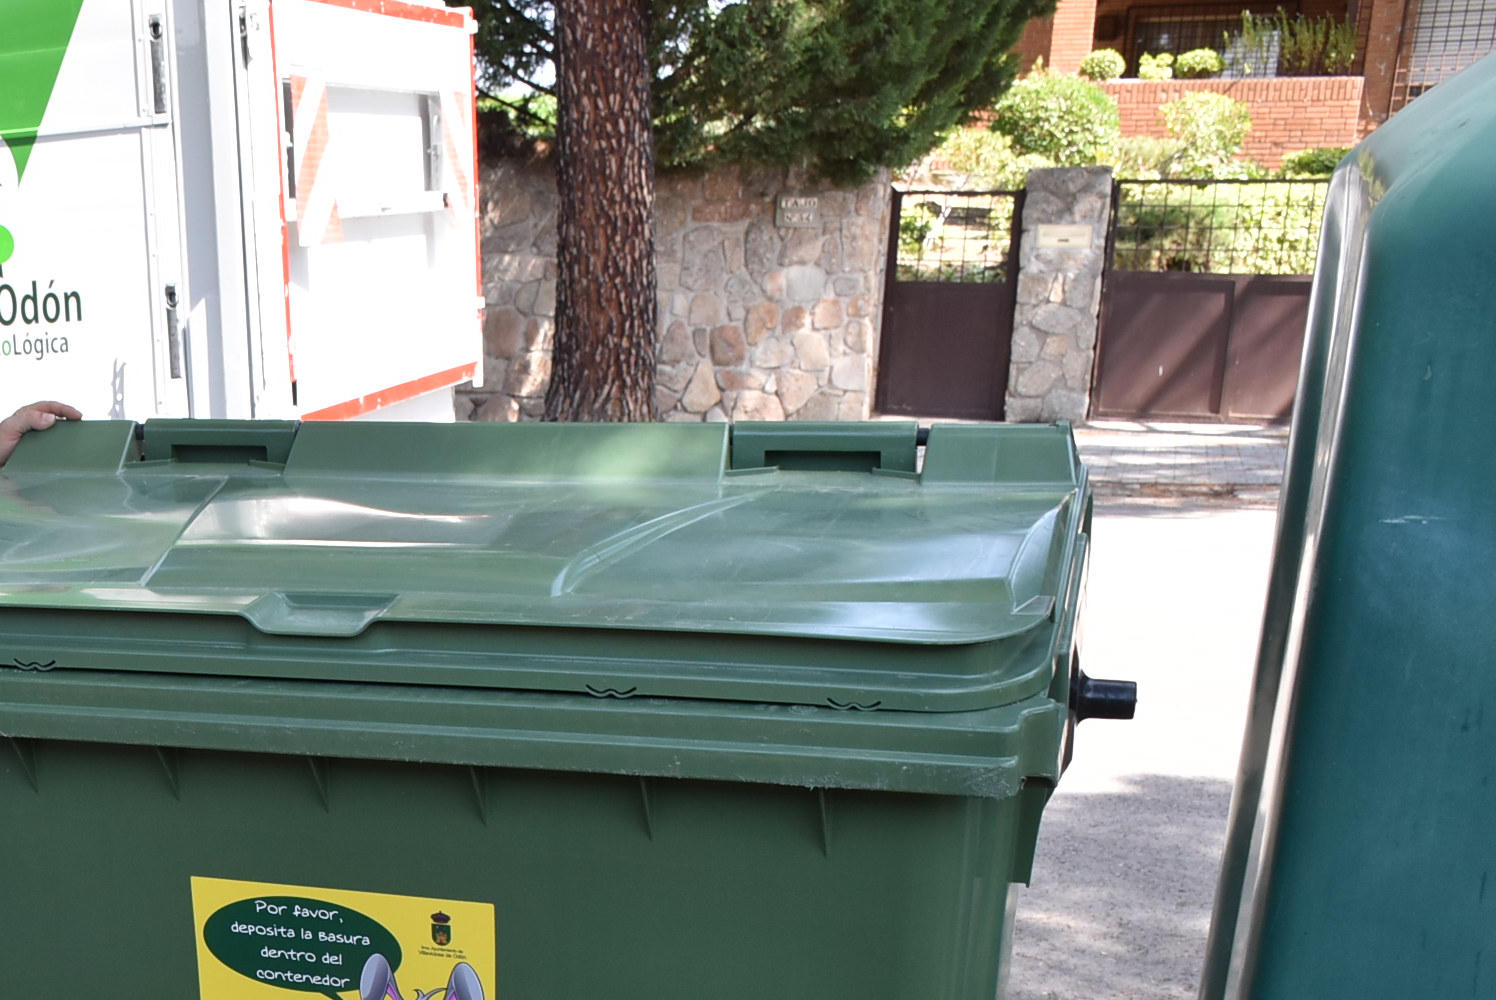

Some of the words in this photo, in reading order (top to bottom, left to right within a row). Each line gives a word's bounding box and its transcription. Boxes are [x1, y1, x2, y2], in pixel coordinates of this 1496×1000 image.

[254, 900, 288, 916] Por
[292, 904, 343, 923] favor,
[230, 921, 296, 939] deposita
[300, 928, 313, 940] la
[318, 931, 371, 946] Basura
[260, 946, 317, 963] dentro
[321, 952, 342, 965] del
[256, 969, 351, 988] contenedor
